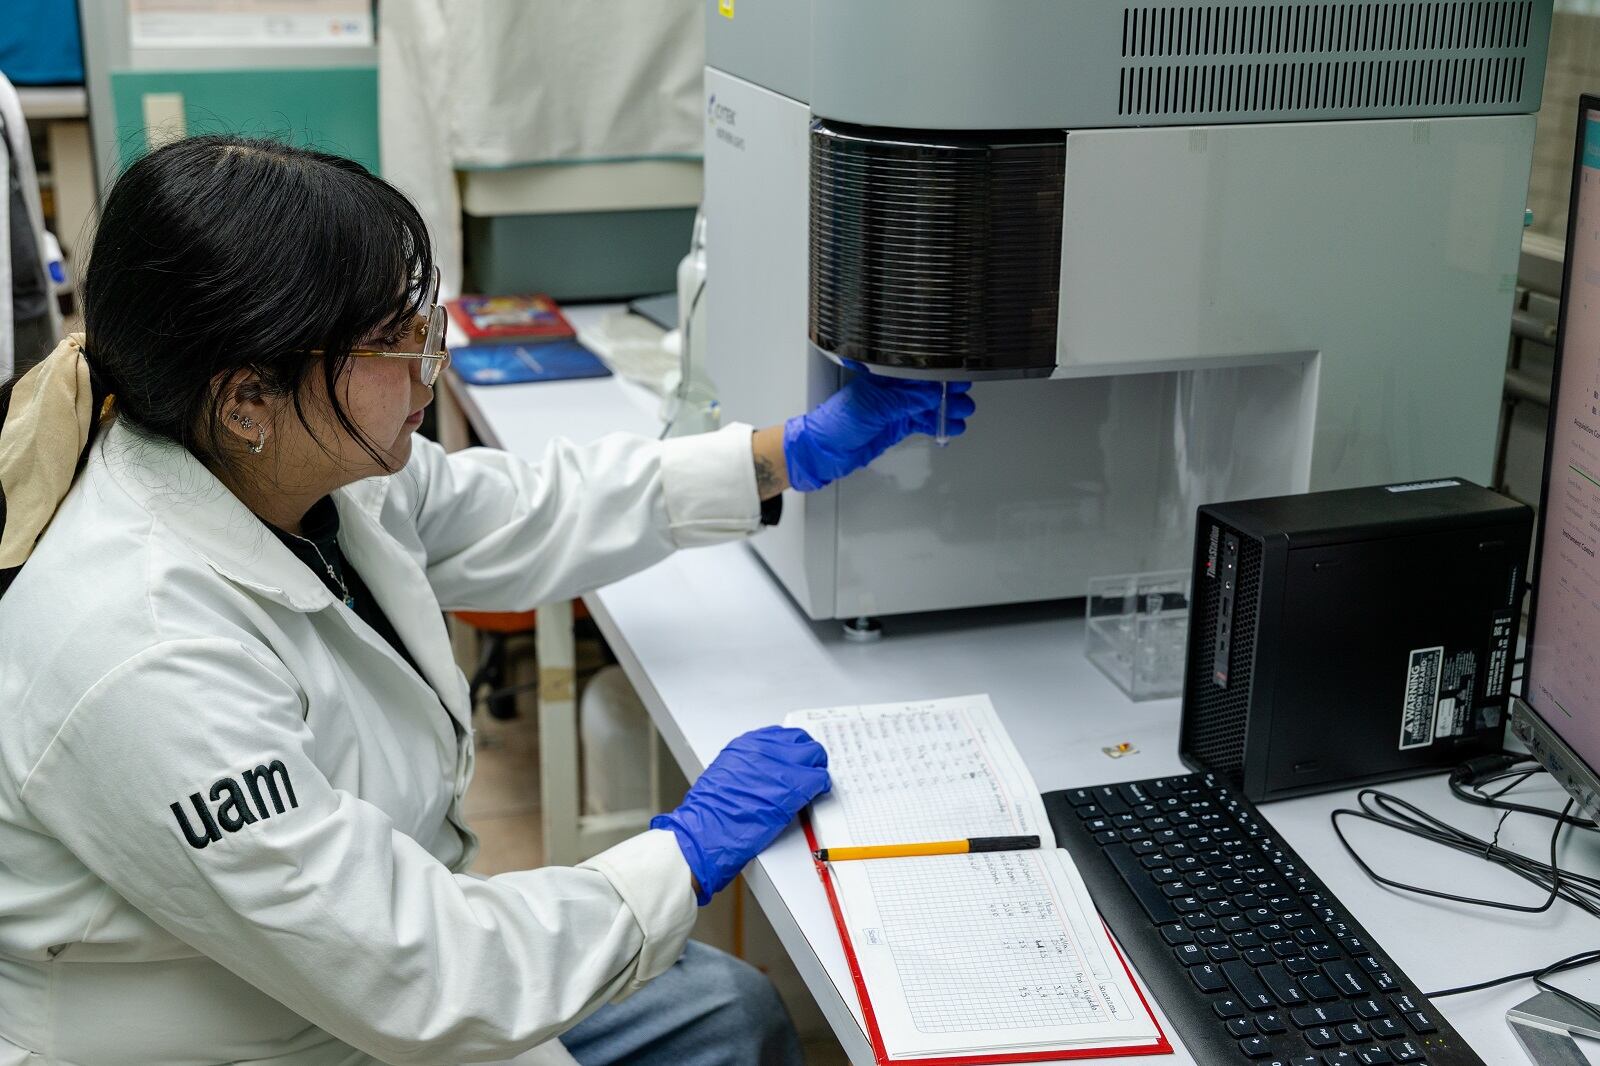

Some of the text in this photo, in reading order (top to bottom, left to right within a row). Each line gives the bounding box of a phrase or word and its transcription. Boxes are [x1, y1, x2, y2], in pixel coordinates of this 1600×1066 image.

[1406, 665, 1420, 721] WARNING
[1412, 695, 1422, 739] INGESTION
[170, 760, 298, 849] uam
[1258, 995, 1268, 1003] Shift
[1289, 989, 1299, 998] Enter
[1315, 1008, 1326, 1019] Delete
